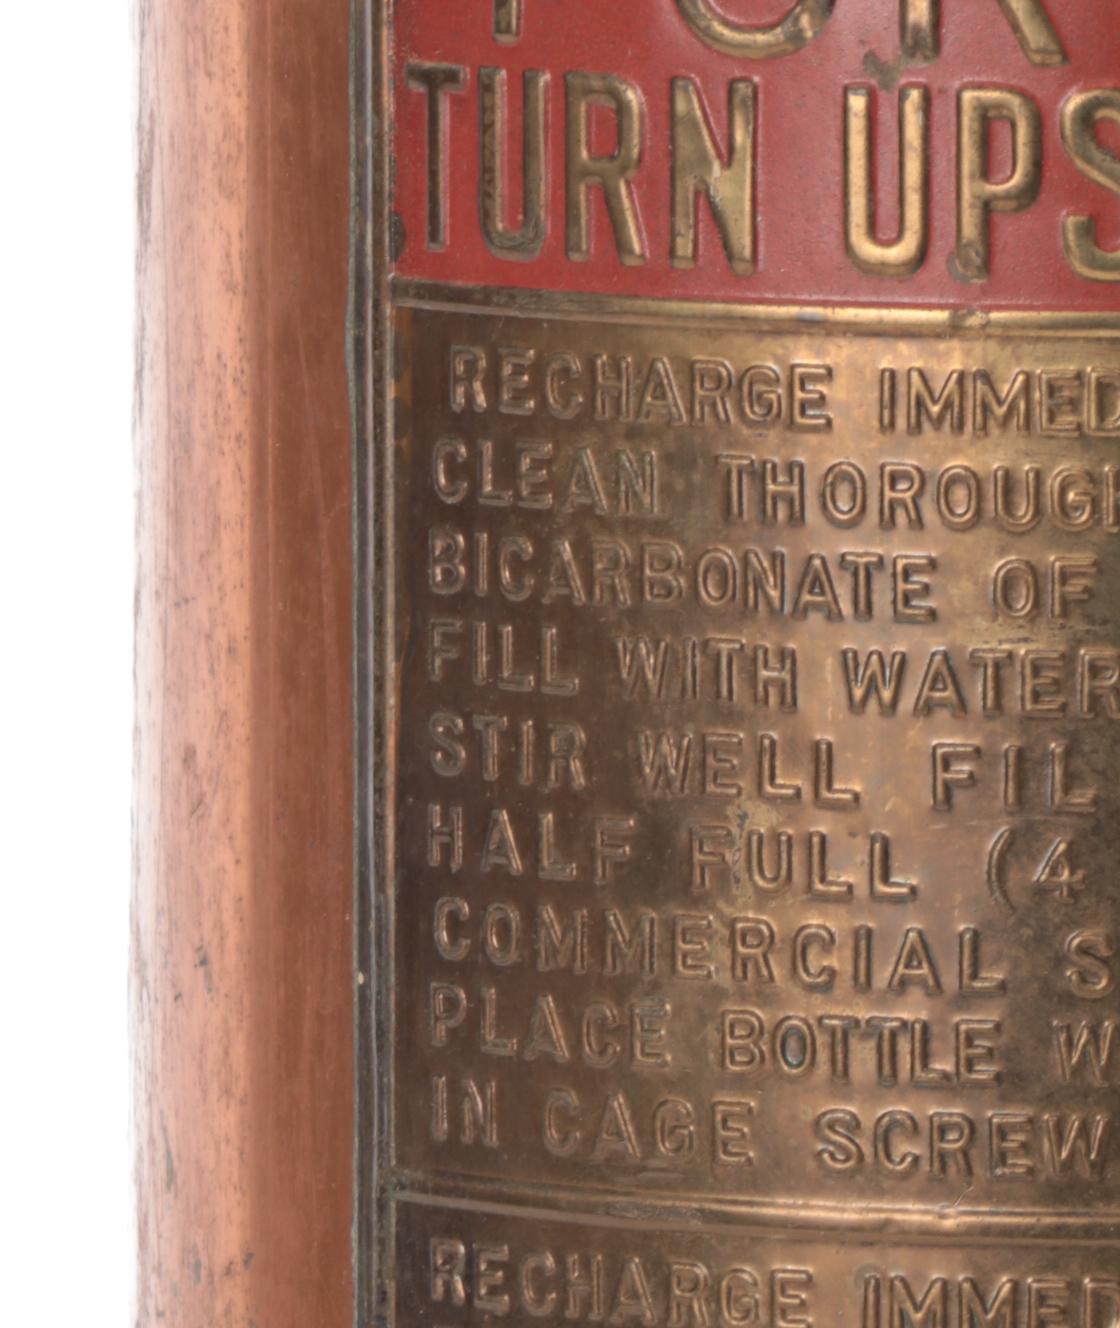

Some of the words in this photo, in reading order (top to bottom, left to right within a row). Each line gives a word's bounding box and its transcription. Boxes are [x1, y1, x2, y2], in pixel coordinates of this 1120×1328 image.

[406, 62, 758, 276] TURN
[447, 343, 833, 431] RECHARGE
[431, 437, 658, 515] CLEAN
[427, 528, 937, 623] BICARBONATE
[991, 554, 1097, 620] OF
[425, 617, 580, 696] FILL
[614, 634, 798, 711] WITH
[429, 712, 588, 791] STIR
[636, 727, 862, 811] WELL
[428, 802, 636, 885] HALF
[692, 826, 919, 902] FULL
[986, 826, 1086, 913] (4
[432, 896, 1006, 994] COMMERCIAL
[429, 982, 672, 1068] PLACE
[720, 1007, 1003, 1088] BOTTLE
[431, 1074, 498, 1146] IN
[542, 1085, 758, 1168] CAGE
[815, 1107, 1108, 1182] SCREW
